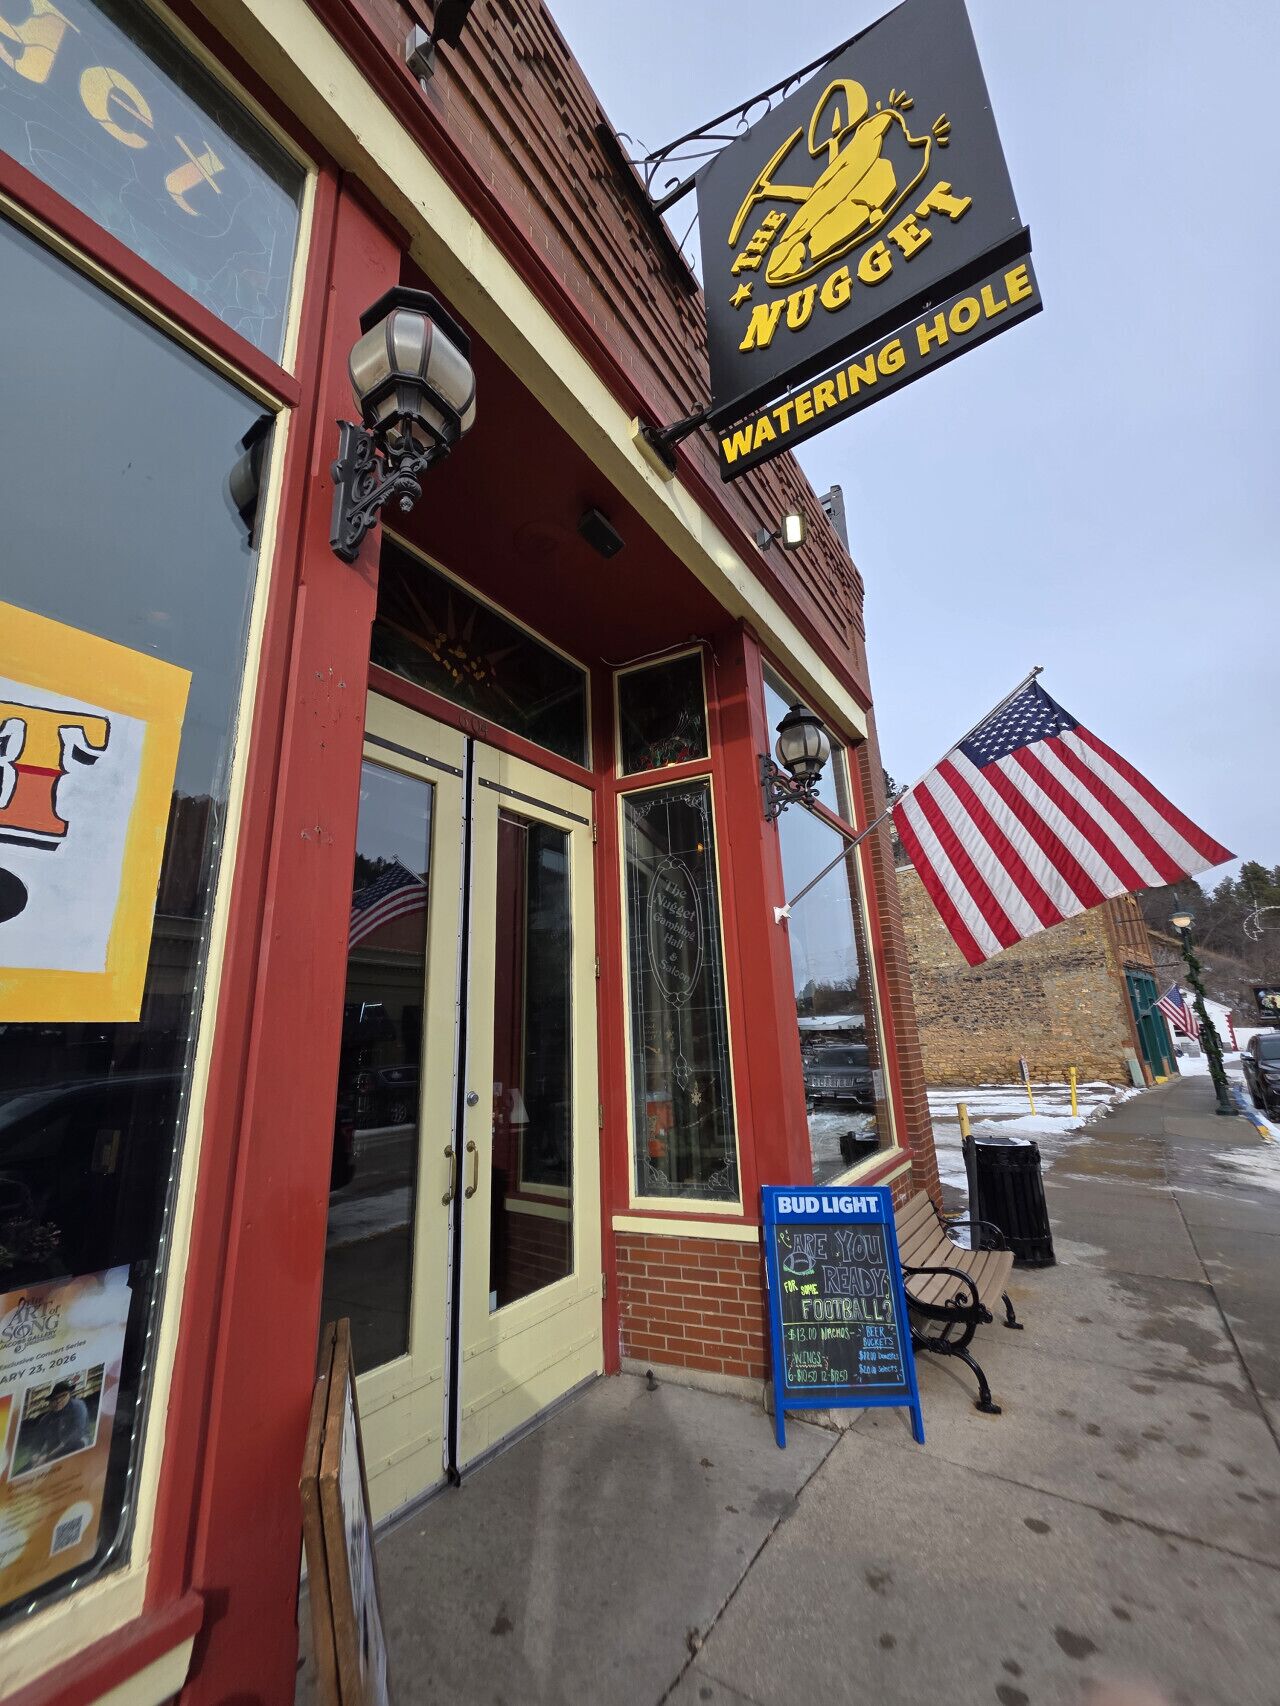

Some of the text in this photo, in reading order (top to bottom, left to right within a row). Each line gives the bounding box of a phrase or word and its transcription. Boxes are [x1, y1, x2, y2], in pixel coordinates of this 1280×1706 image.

[730, 209, 787, 276] THE
[738, 181, 973, 353] NUGGET
[721, 263, 1034, 464] WATERING HOLE
[665, 879, 688, 899] The
[653, 892, 696, 922] Nugget
[653, 912, 696, 942] Gambling
[664, 932, 684, 950] Hall
[669, 952, 678, 962] &
[660, 960, 691, 984] Saloon
[778, 1196, 879, 1214] BUD LIGHT
[793, 1230, 883, 1264] ARE YOU
[784, 1279, 819, 1296] FOR SOME
[822, 1265, 887, 1298] READY
[1, 1314, 60, 1341] SONG
[866, 1325, 886, 1338] BEER
[35, 1347, 65, 1361] Concert
[65, 1340, 88, 1352] Series
[28, 1363, 46, 1377] 23,
[49, 1352, 77, 1370] 2026
